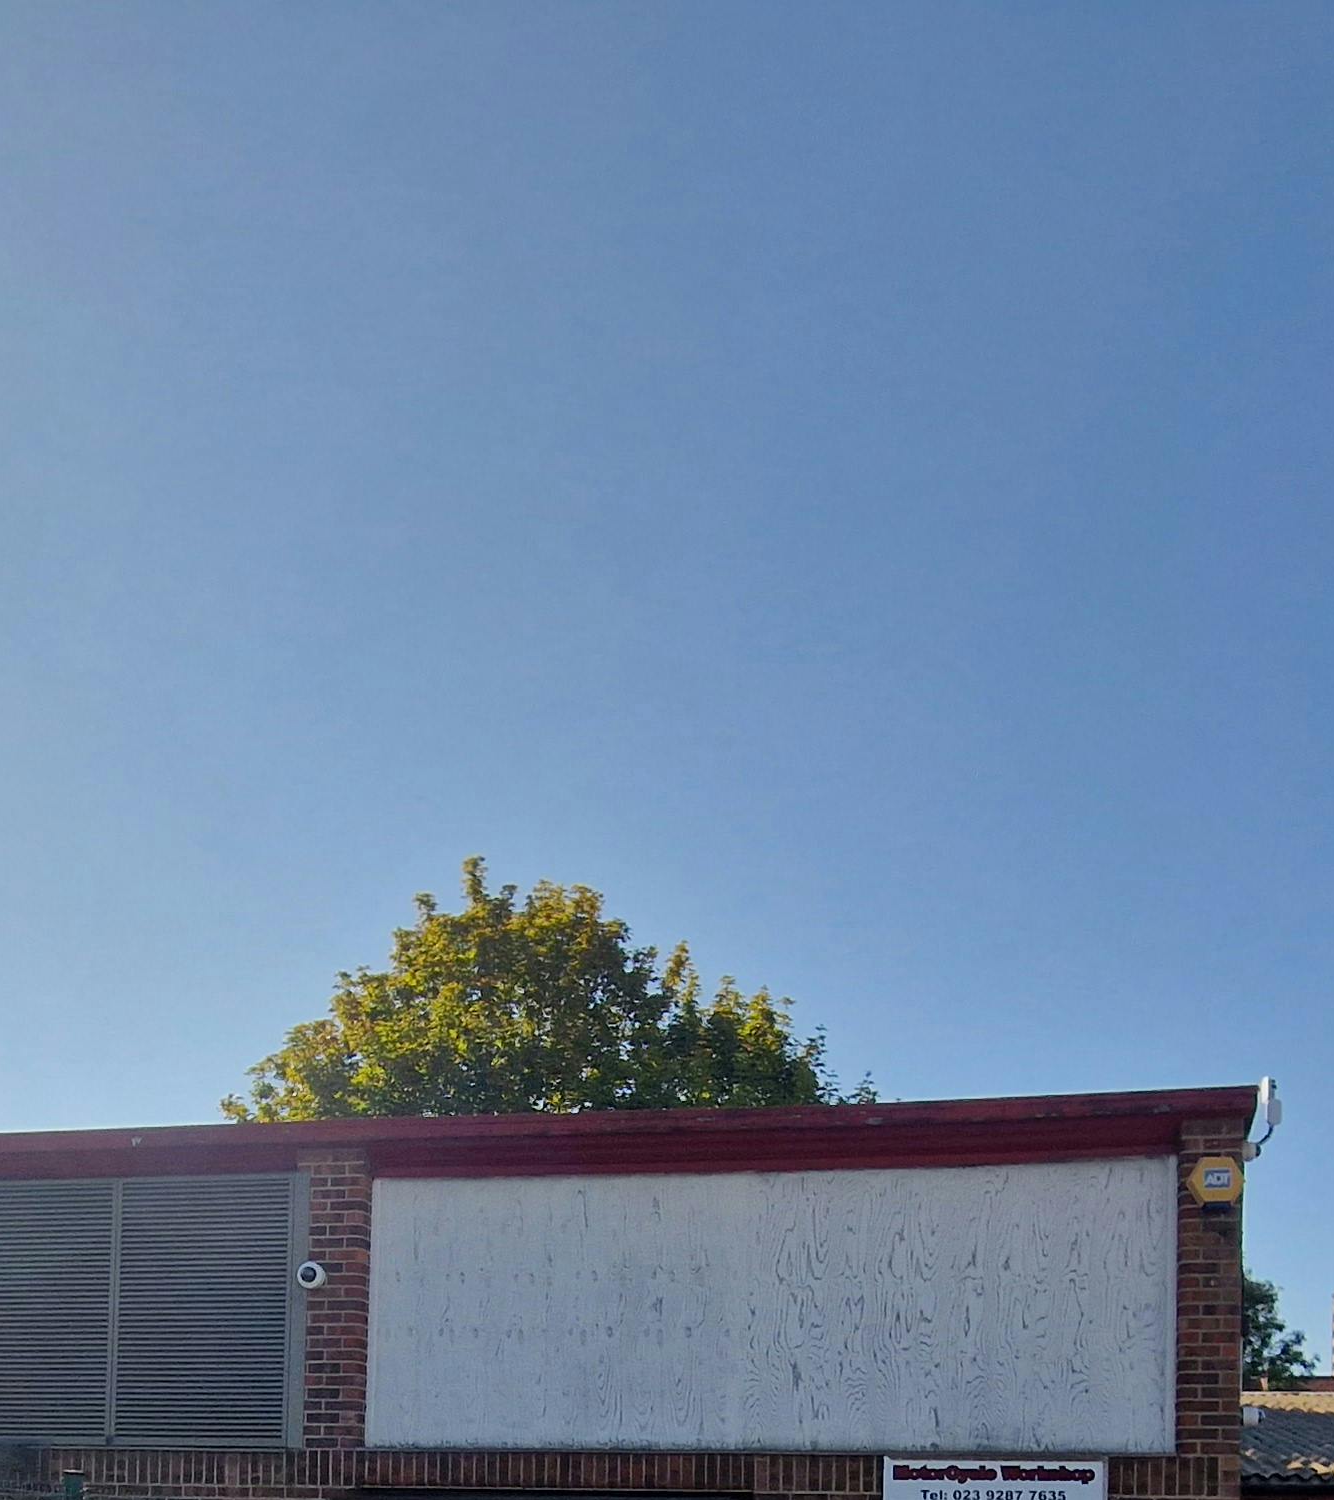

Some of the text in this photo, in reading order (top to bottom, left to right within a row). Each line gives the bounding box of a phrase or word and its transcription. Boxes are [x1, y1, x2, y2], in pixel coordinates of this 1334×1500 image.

[1204, 1173, 1230, 1186] ADT
[1000, 1465, 1095, 1485] Workshop
[920, 1489, 1066, 1500] Tel: 023 9287 7635
